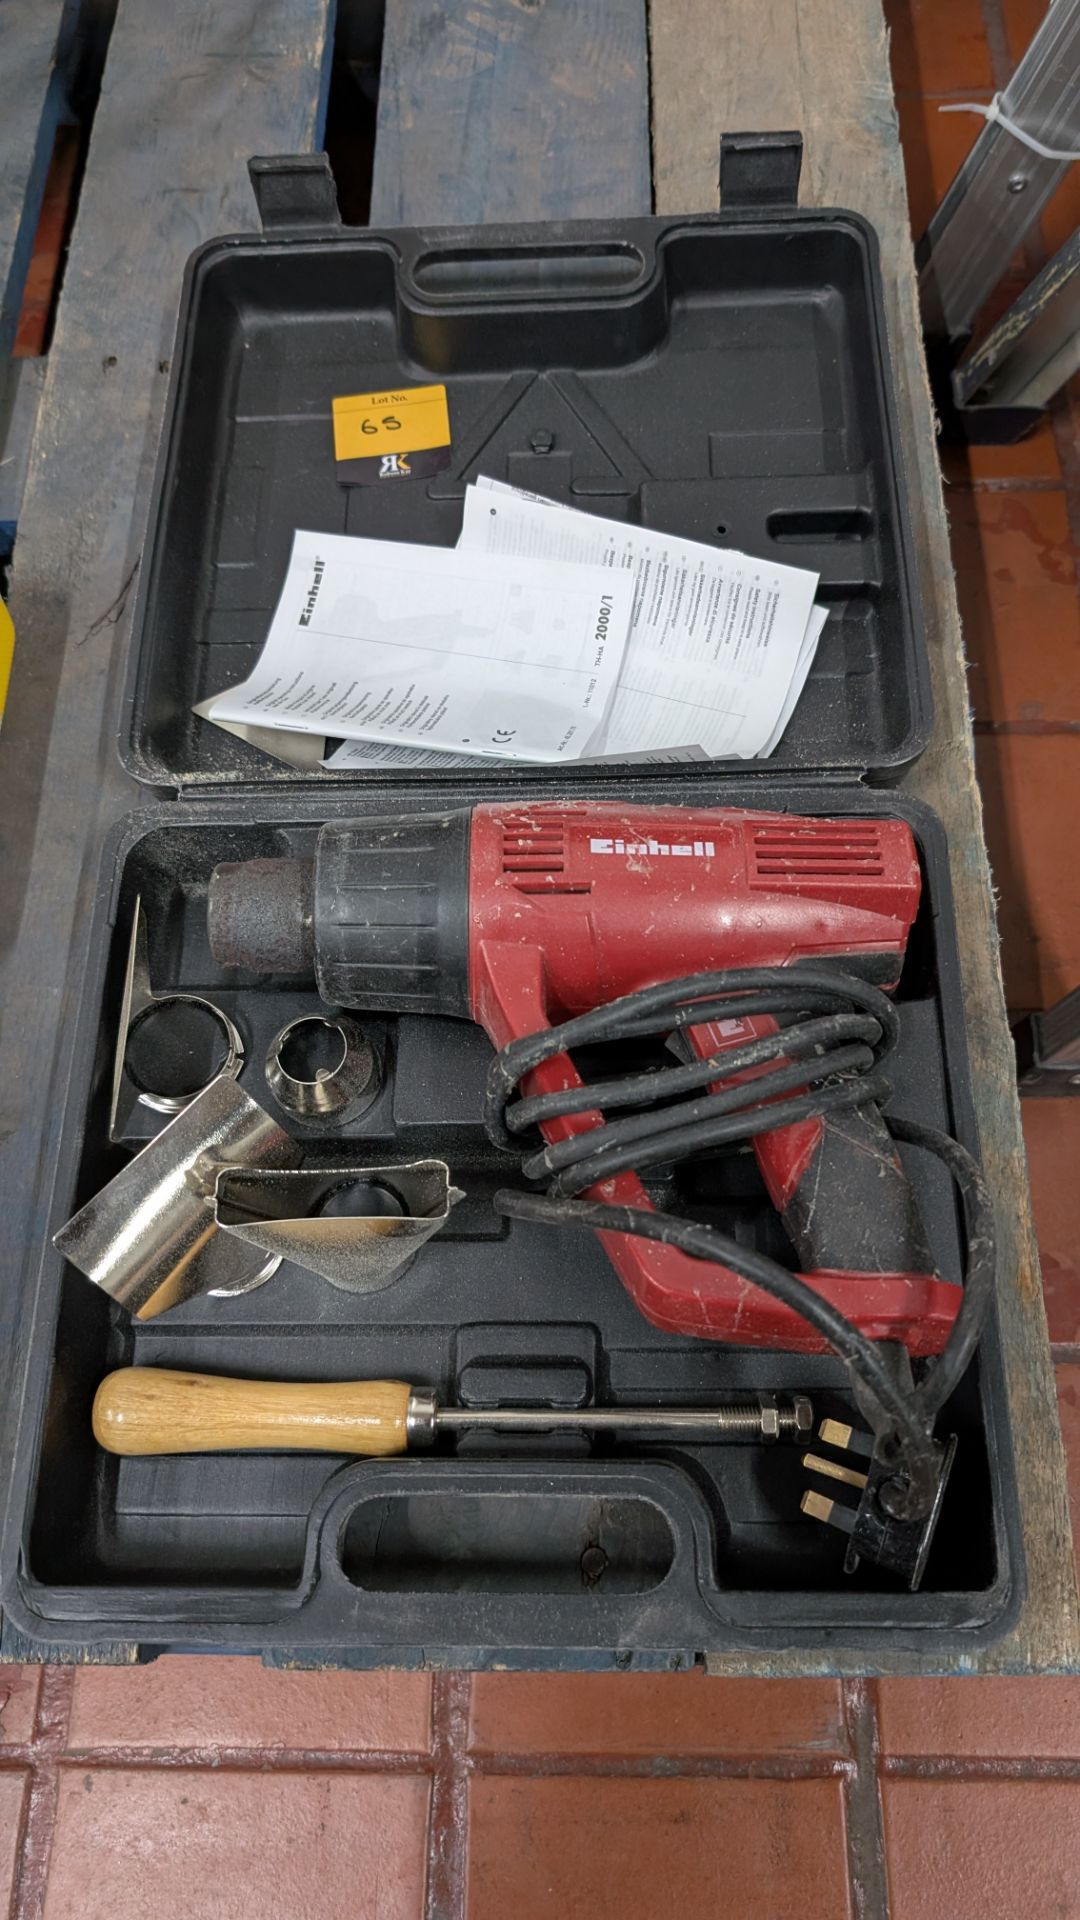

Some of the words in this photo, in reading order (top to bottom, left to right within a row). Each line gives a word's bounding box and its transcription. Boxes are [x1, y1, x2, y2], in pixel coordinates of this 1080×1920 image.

[371, 396, 389, 405] Lot
[390, 395, 408, 403] No.
[361, 416, 402, 435] 65
[298, 560, 326, 627] Einhell
[595, 595, 613, 641] 2000/1
[590, 838, 715, 857] Einhell
